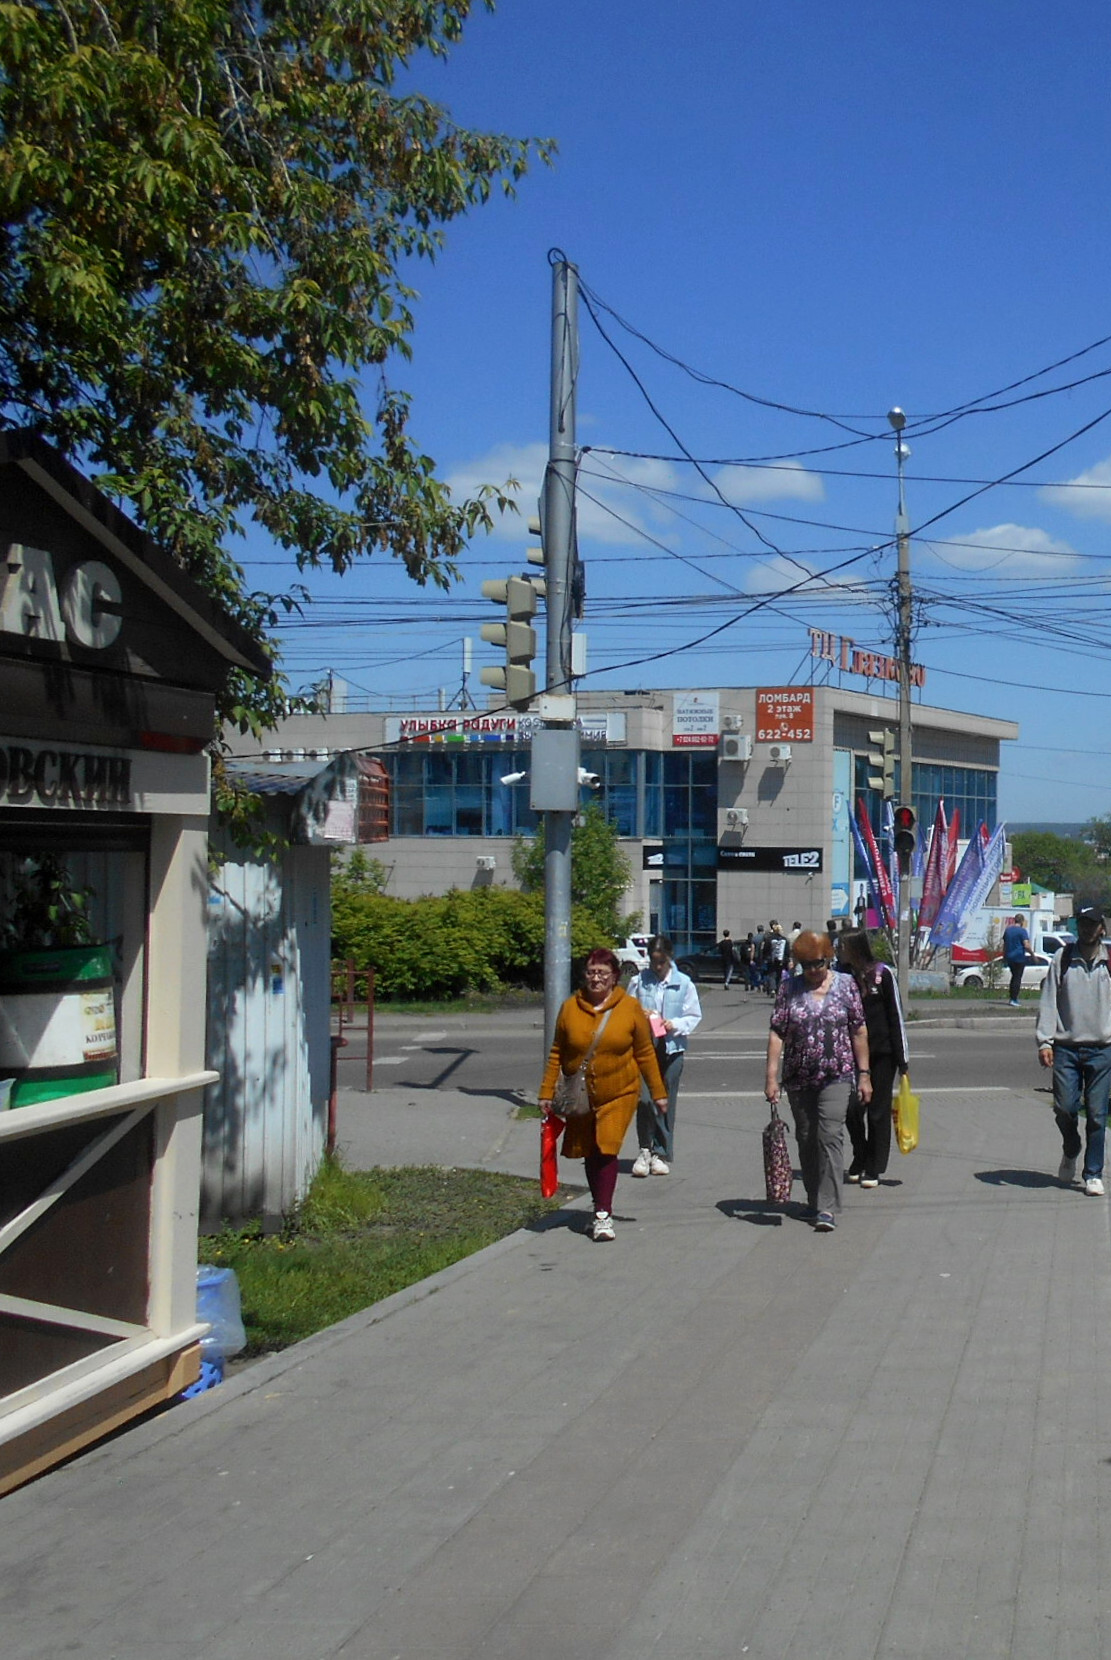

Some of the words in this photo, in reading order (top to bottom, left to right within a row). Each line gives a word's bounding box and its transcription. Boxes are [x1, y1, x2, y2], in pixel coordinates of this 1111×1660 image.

[808, 628, 836, 667] ТЦ
[758, 693, 811, 703] ЛОМБАРД
[767, 705, 774, 713] 2
[776, 705, 801, 713] этаж
[758, 729, 811, 739] 622-452
[783, 851, 820, 867] TELE2
